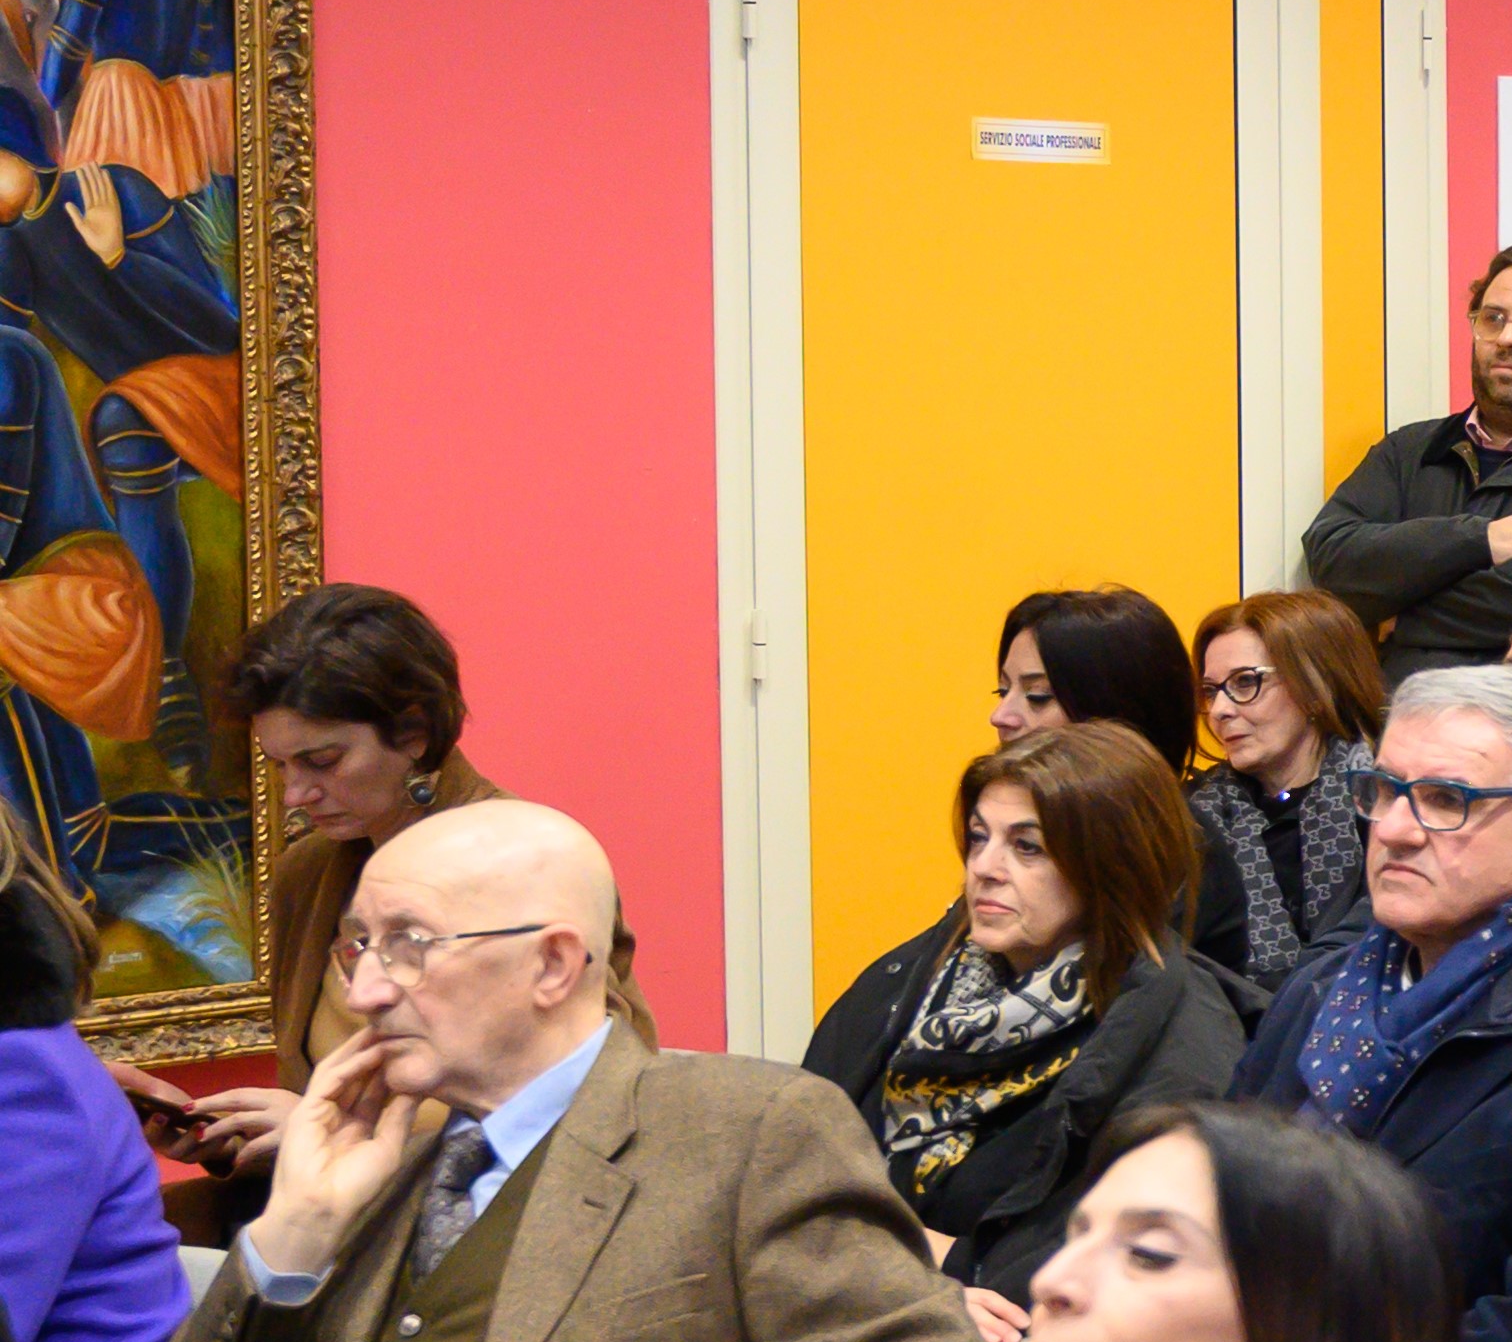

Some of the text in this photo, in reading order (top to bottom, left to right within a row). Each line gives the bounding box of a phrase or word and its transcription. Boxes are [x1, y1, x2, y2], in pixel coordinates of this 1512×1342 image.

[979, 131, 1101, 150] SERVIZIO SOCIALE PROFESSIONALE
